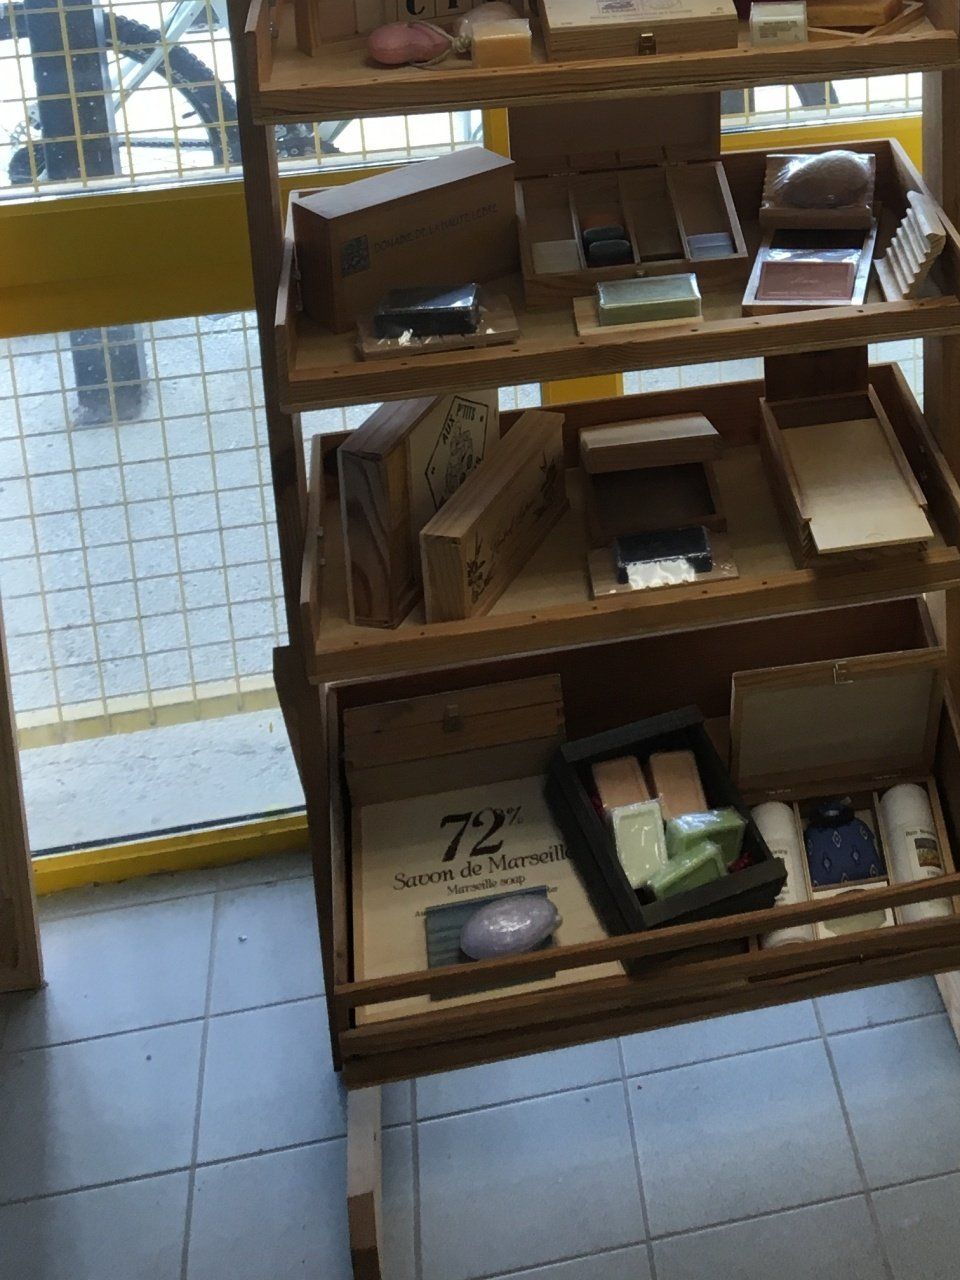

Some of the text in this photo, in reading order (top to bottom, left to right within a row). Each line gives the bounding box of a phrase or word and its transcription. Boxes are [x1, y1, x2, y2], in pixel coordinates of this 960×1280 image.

[392, 867, 455, 892] Savon
[460, 861, 483, 879] de
[446, 878, 498, 897] Marseille
